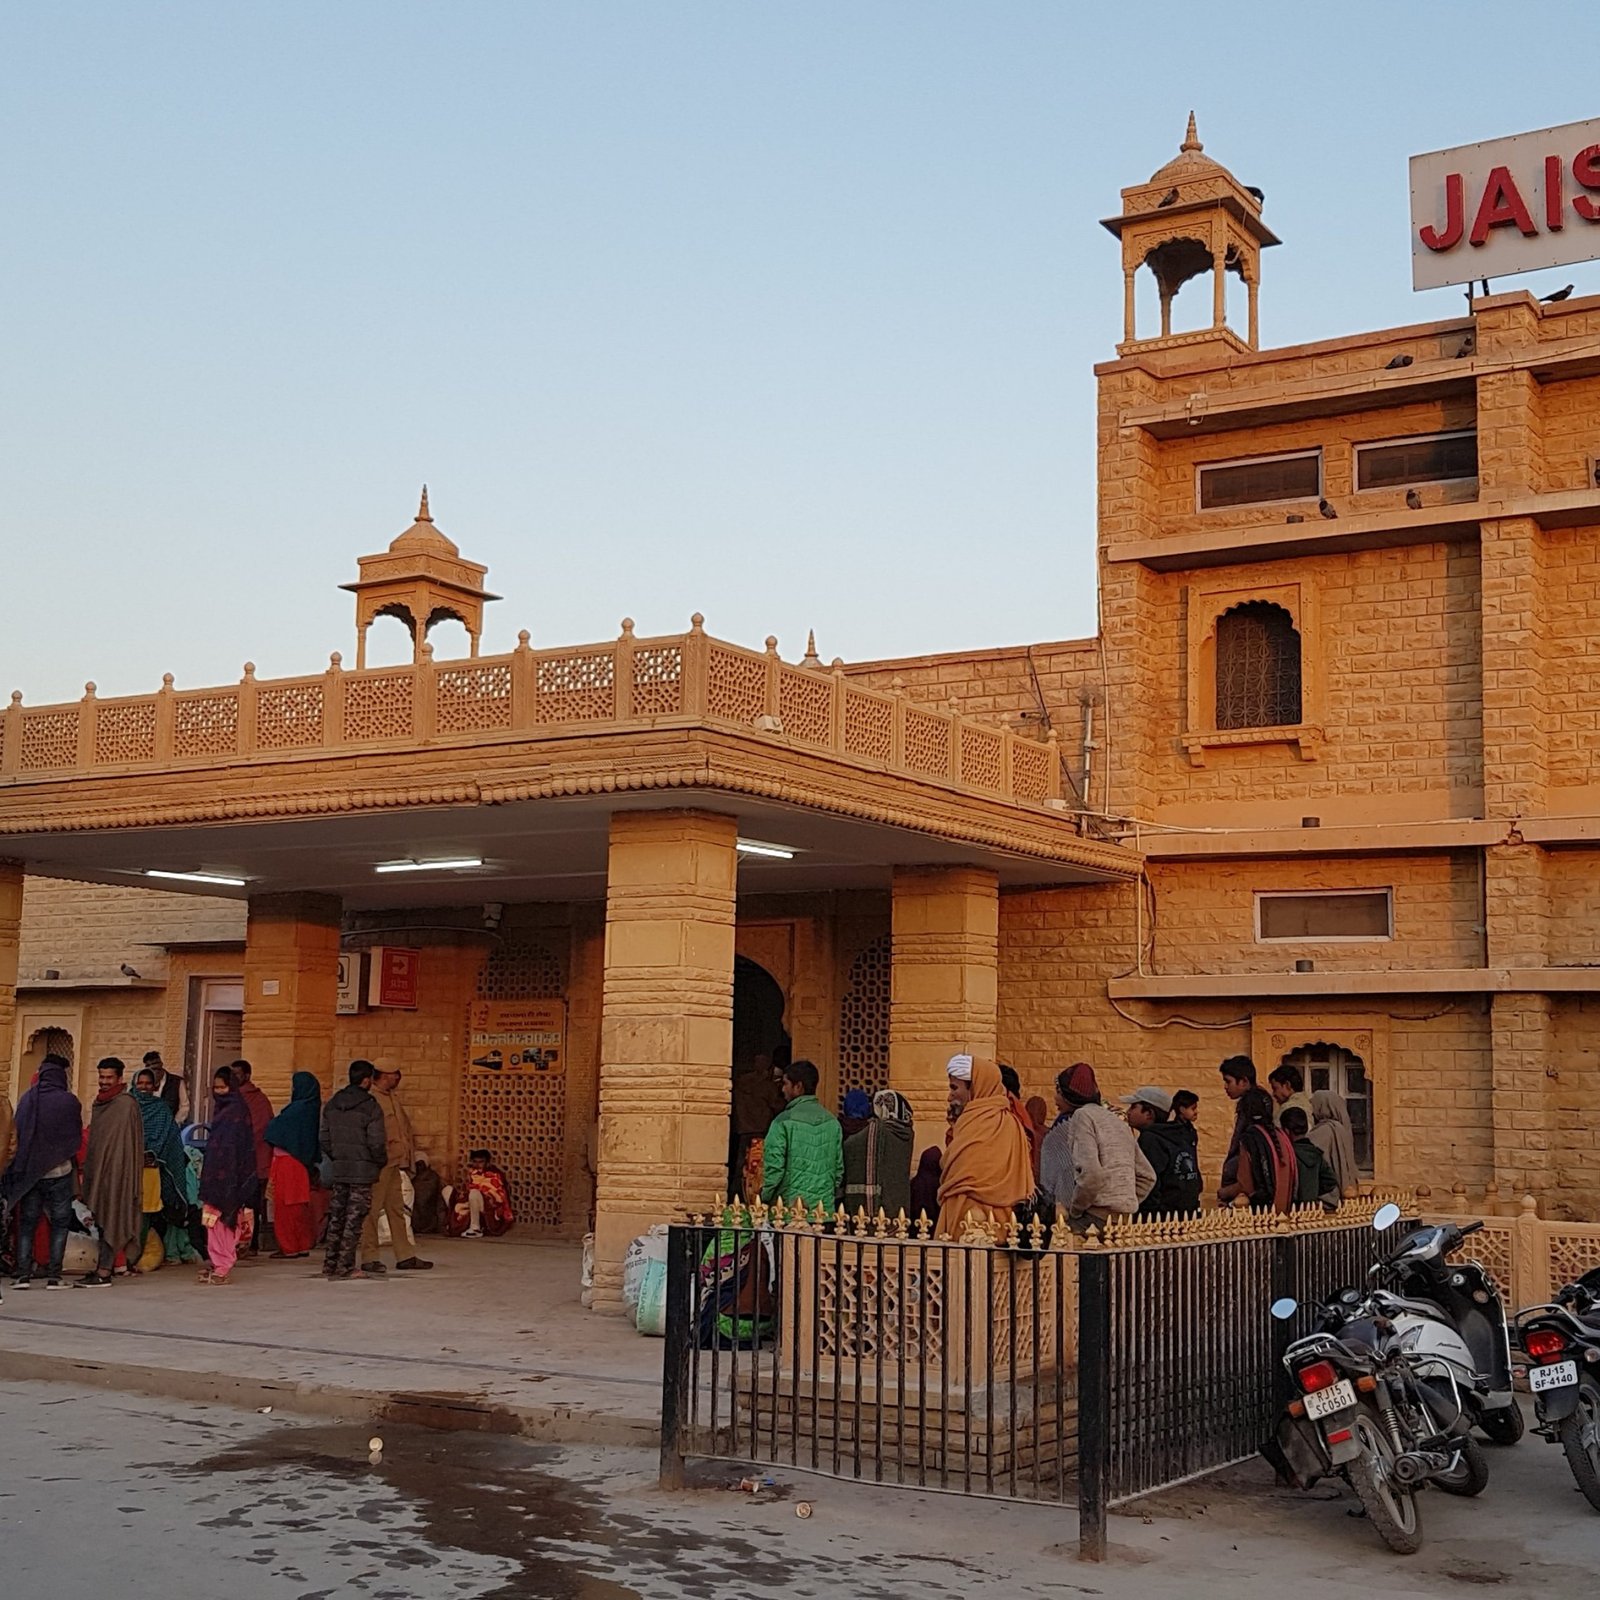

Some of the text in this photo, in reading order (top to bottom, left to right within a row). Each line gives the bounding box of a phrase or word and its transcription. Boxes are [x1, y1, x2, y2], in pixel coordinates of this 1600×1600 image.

[1535, 1374, 1573, 1389] SF-4140
[1316, 1385, 1342, 1402] RJ15
[1315, 1393, 1353, 1415] SC0501
